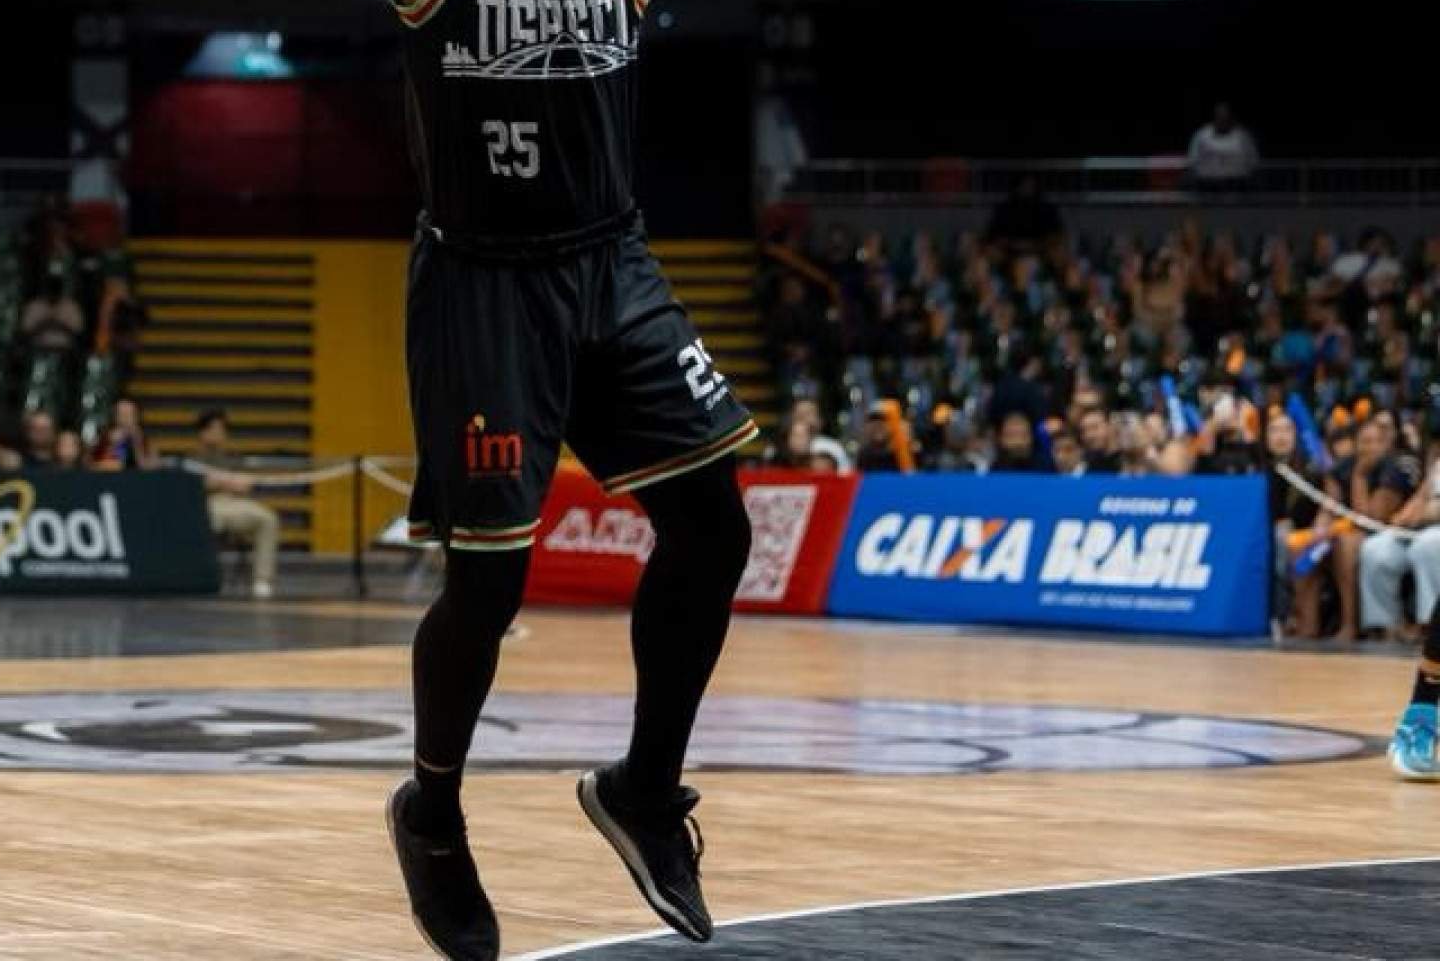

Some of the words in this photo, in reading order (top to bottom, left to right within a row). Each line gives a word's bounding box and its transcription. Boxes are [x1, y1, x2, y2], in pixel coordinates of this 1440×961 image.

[481, 119, 541, 179] 25
[856, 513, 1035, 583] CAIXA
[1040, 519, 1213, 589] BRASIL
